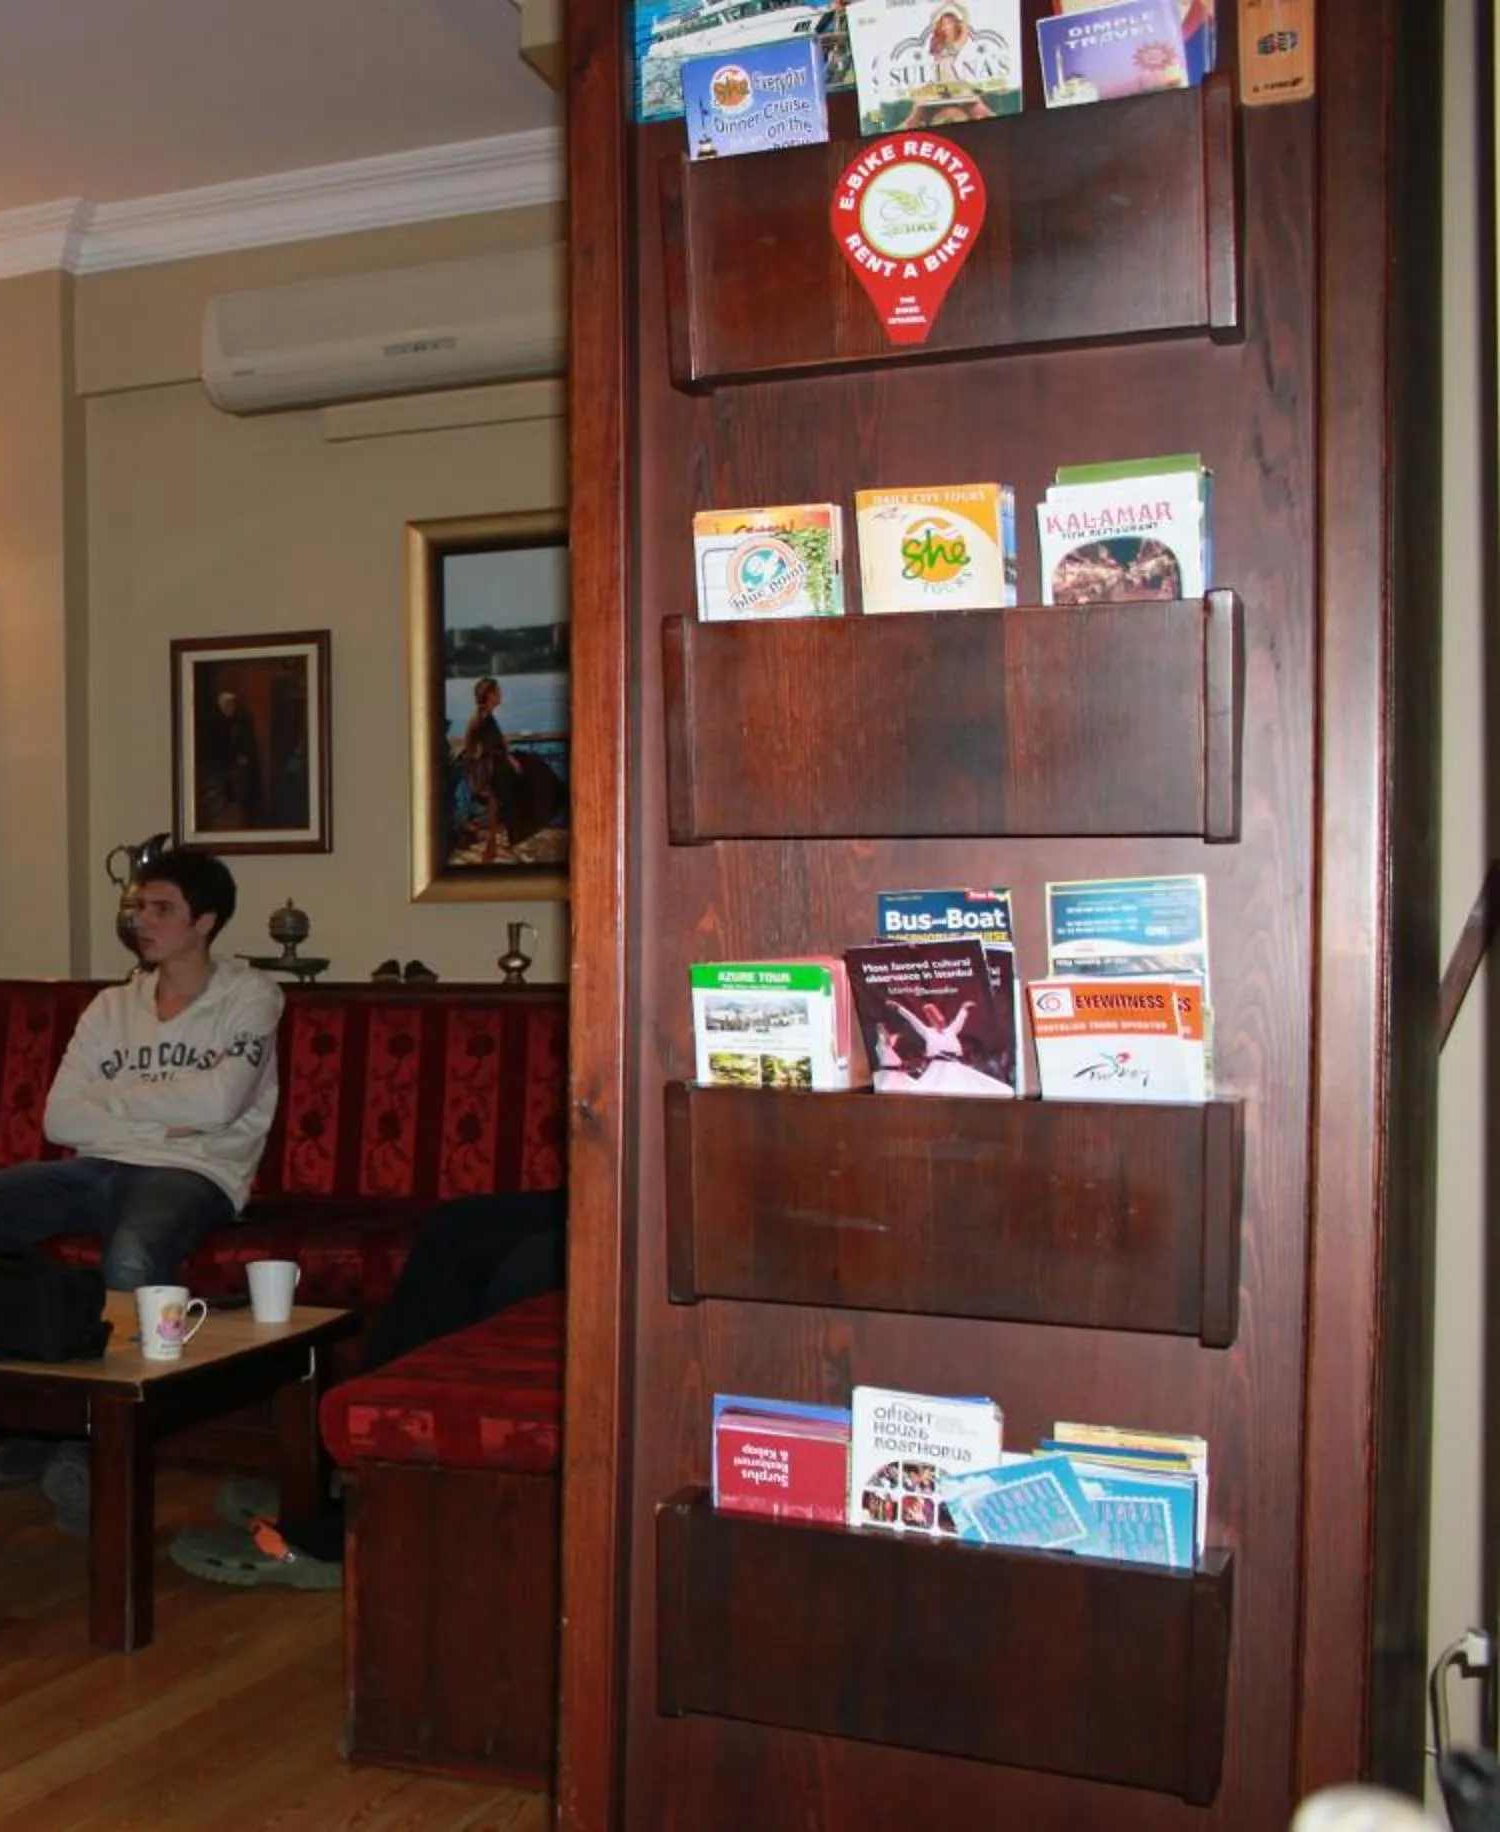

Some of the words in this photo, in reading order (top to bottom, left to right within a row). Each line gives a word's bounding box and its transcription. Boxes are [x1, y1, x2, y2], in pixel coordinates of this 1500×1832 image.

[1065, 25, 1155, 49] TRAVEL
[1068, 12, 1153, 37] DIMPLE
[714, 114, 759, 133] Dinner
[763, 98, 810, 118] Cruise
[767, 122, 785, 137] on
[789, 116, 812, 132] the
[839, 145, 896, 210] E-BIKE
[903, 140, 975, 200] RENTAL
[845, 232, 897, 277] RENT
[903, 263, 918, 279] A
[924, 223, 969, 272] BIKE
[1046, 501, 1173, 534] KALAMAR
[901, 529, 972, 580] she
[1075, 994, 1165, 1009] EYEWITNESS
[874, 1404, 932, 1424] ORIENT
[873, 1421, 929, 1440] HOUSE
[874, 1436, 972, 1461] BOSPHORUS
[741, 1468, 789, 1487] Surplus
